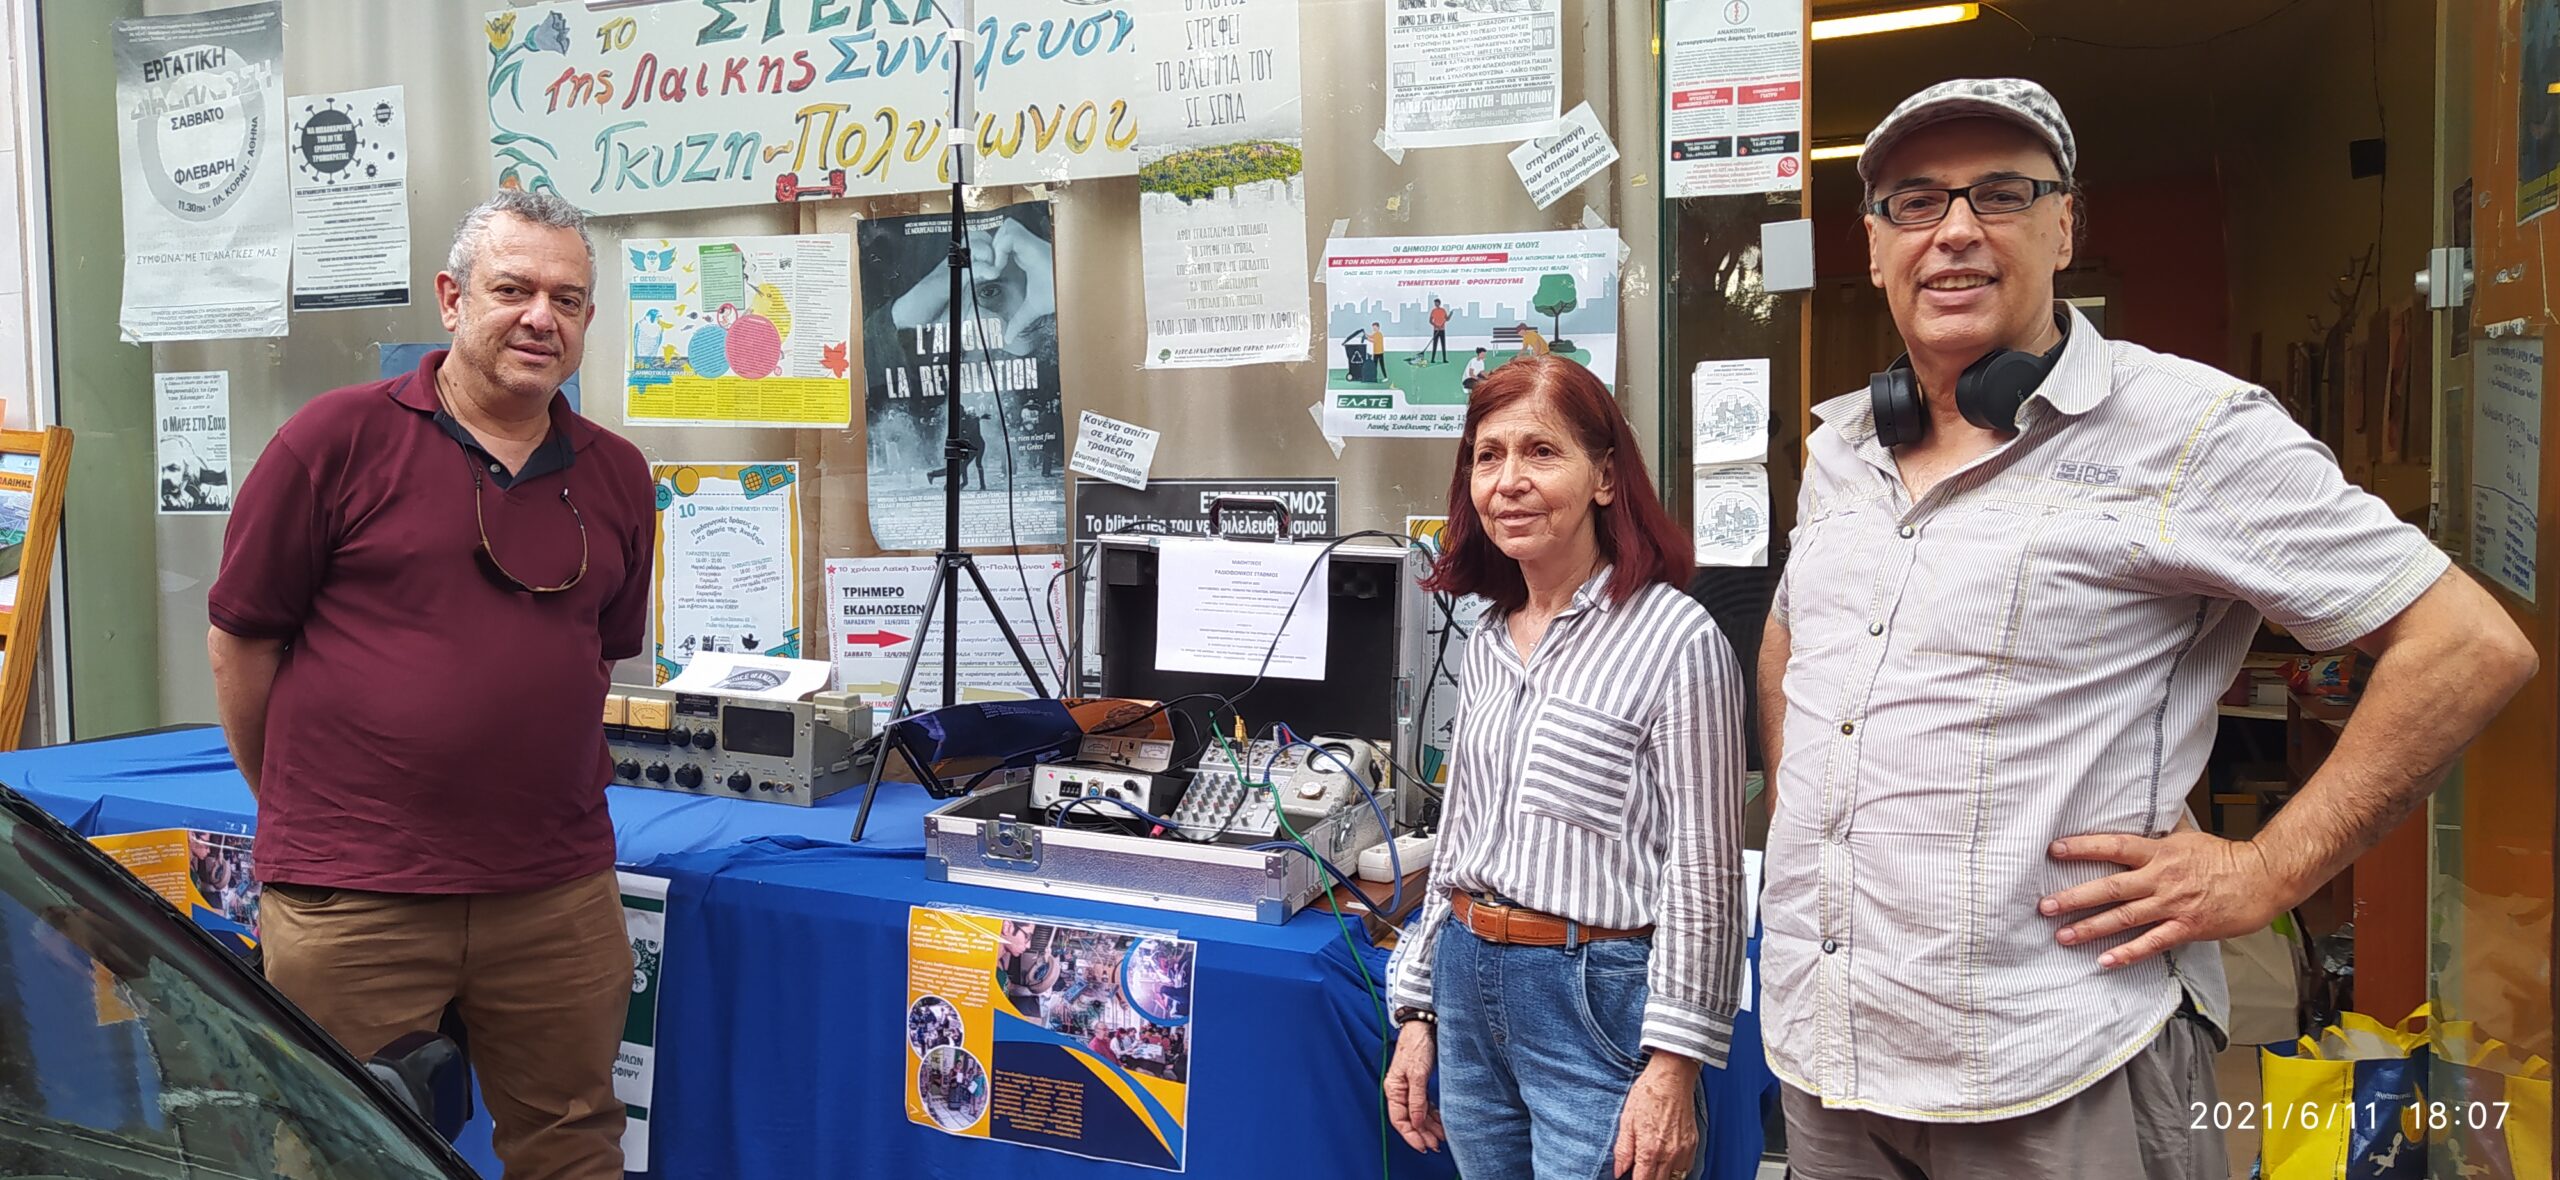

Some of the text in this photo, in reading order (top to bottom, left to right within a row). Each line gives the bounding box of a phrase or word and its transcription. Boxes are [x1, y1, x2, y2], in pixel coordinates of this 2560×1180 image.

[597, 15, 638, 54] ΤΟ
[1186, 14, 1240, 50] ΣΤΡΕΦΕΙ
[143, 46, 226, 83] ΕΡΓΑΤΙΚΗ
[1156, 49, 1273, 92] ΤΟ ΒΛΕΜΜΑ ΤΟΥ
[1501, 89, 1553, 106] ΠΟΛΥΓΩΝΟΥ
[171, 107, 224, 130] ΣΑΒΒΑΤΟ
[1186, 93, 1246, 128] ΣΕ ΣΕΝΑ
[225, 165, 250, 197] ΚΟΡΑΗ
[247, 116, 258, 157] ΑΘΗΝΑ
[1524, 132, 1600, 187] των σπιτιών μας
[1525, 152, 1548, 171] στην
[1560, 145, 1606, 180] Πρωτοβουλία
[174, 158, 235, 185] ΦΛΕΒΑΡΗ
[137, 253, 181, 264] ΣΥΜΦΩΝΑ
[185, 253, 197, 262] ΜΕ
[257, 248, 278, 257] ΜΑΣ
[1402, 245, 1439, 253] ΔΗΜΟΣΙΟΙ
[1465, 243, 1502, 251] ΑΝΗΚΟΥΝ
[1397, 277, 1525, 287] ΣΥΜΜΕΤΕΧΟΥΜΕ ΦΡΟΝΤΙΖΟΥΜΕ
[1252, 313, 1265, 330] ΤΟΥ
[916, 317, 1003, 356] L'AOUR
[885, 366, 910, 398] LA
[1337, 397, 1389, 407] ΕΛΑΤΕ
[169, 416, 190, 432] ΜΑΡΞ
[192, 417, 206, 431] ΣΤΟ
[207, 415, 226, 430] ΣΟΧΟ
[1083, 414, 1150, 440] Κανένα σπίτι
[1044, 432, 1056, 442] fini
[1090, 429, 1133, 447] σε χέρια
[1087, 440, 1135, 462] τραπεζίτη
[1074, 451, 1142, 476] Ενωτική Πρωτοβουλία
[679, 503, 696, 518] 10
[1085, 515, 1100, 532] Το
[842, 586, 904, 597] ΤΡΙΗΜΕΡΟ
[843, 605, 926, 615] ΕΚΔΗΛΩΣΕΩΝ
